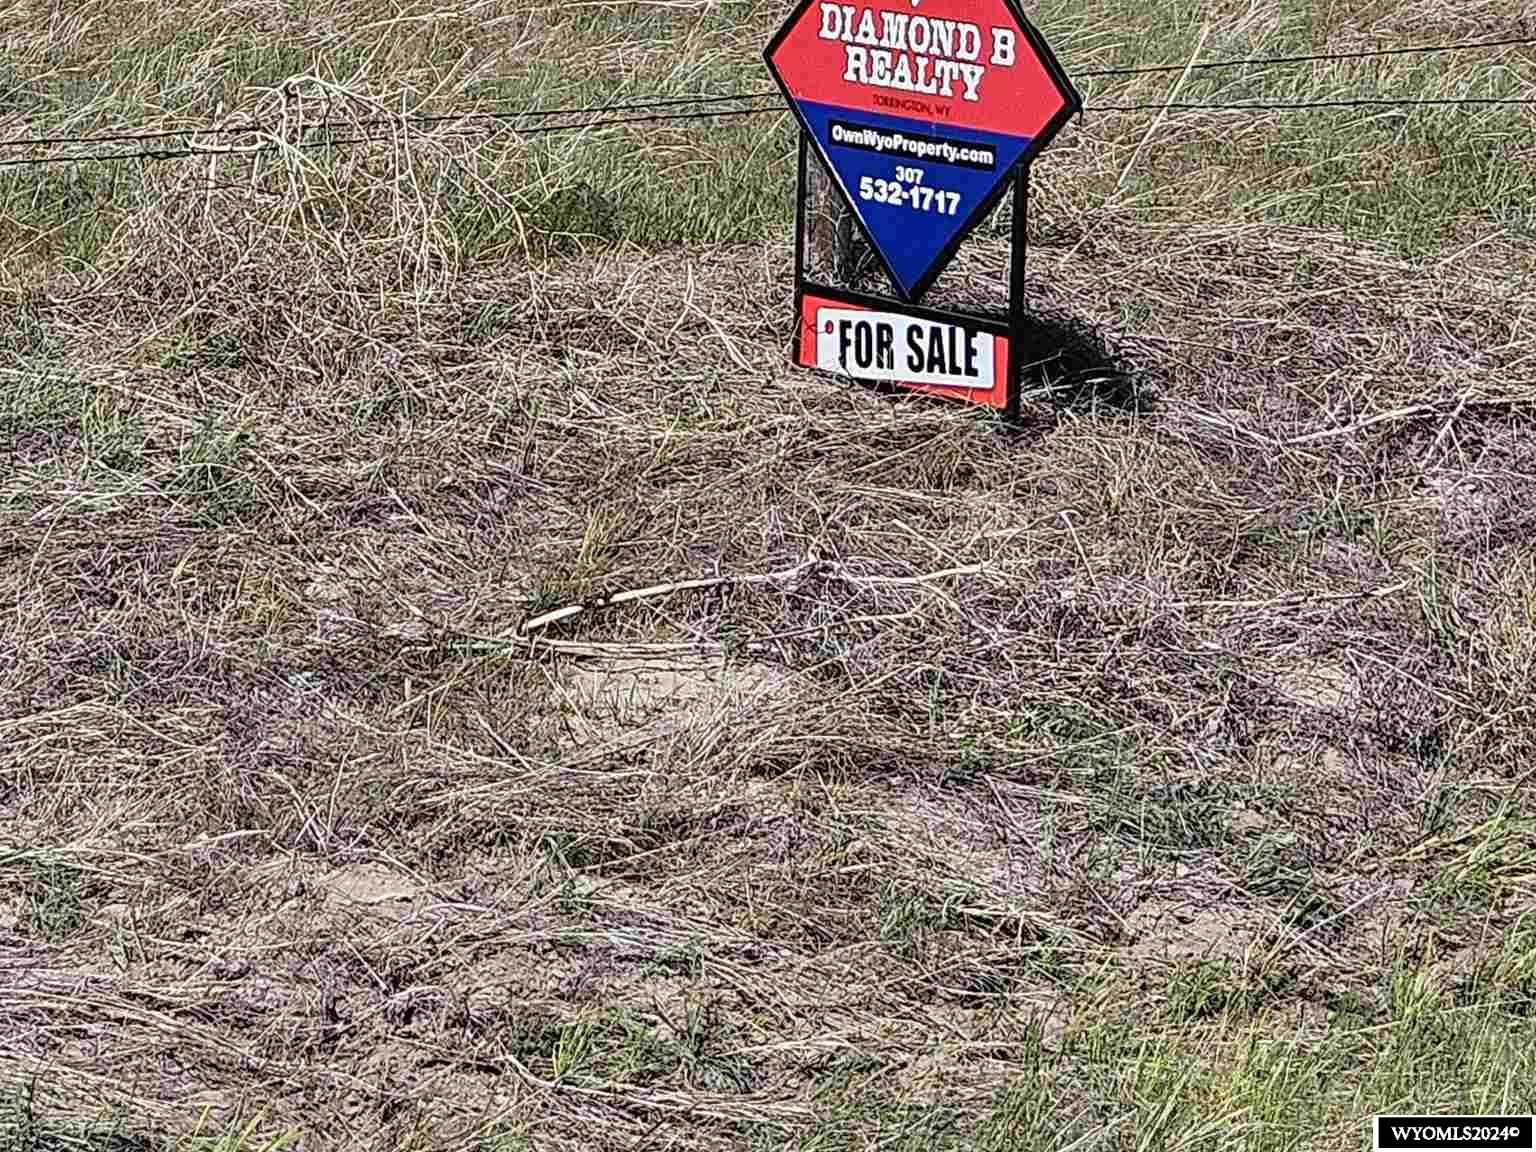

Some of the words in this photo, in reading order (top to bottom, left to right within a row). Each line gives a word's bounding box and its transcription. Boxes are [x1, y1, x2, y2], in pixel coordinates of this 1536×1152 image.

[818, 2, 982, 61] DIAMOND
[990, 27, 1016, 66] B
[843, 45, 985, 101] REALTY
[934, 103, 952, 117] WY
[832, 126, 994, 164] OwnWyoProperty.com
[895, 165, 924, 185] 307
[859, 176, 961, 215] 532-1717
[838, 320, 894, 370] FOR
[906, 325, 979, 377] SALE
